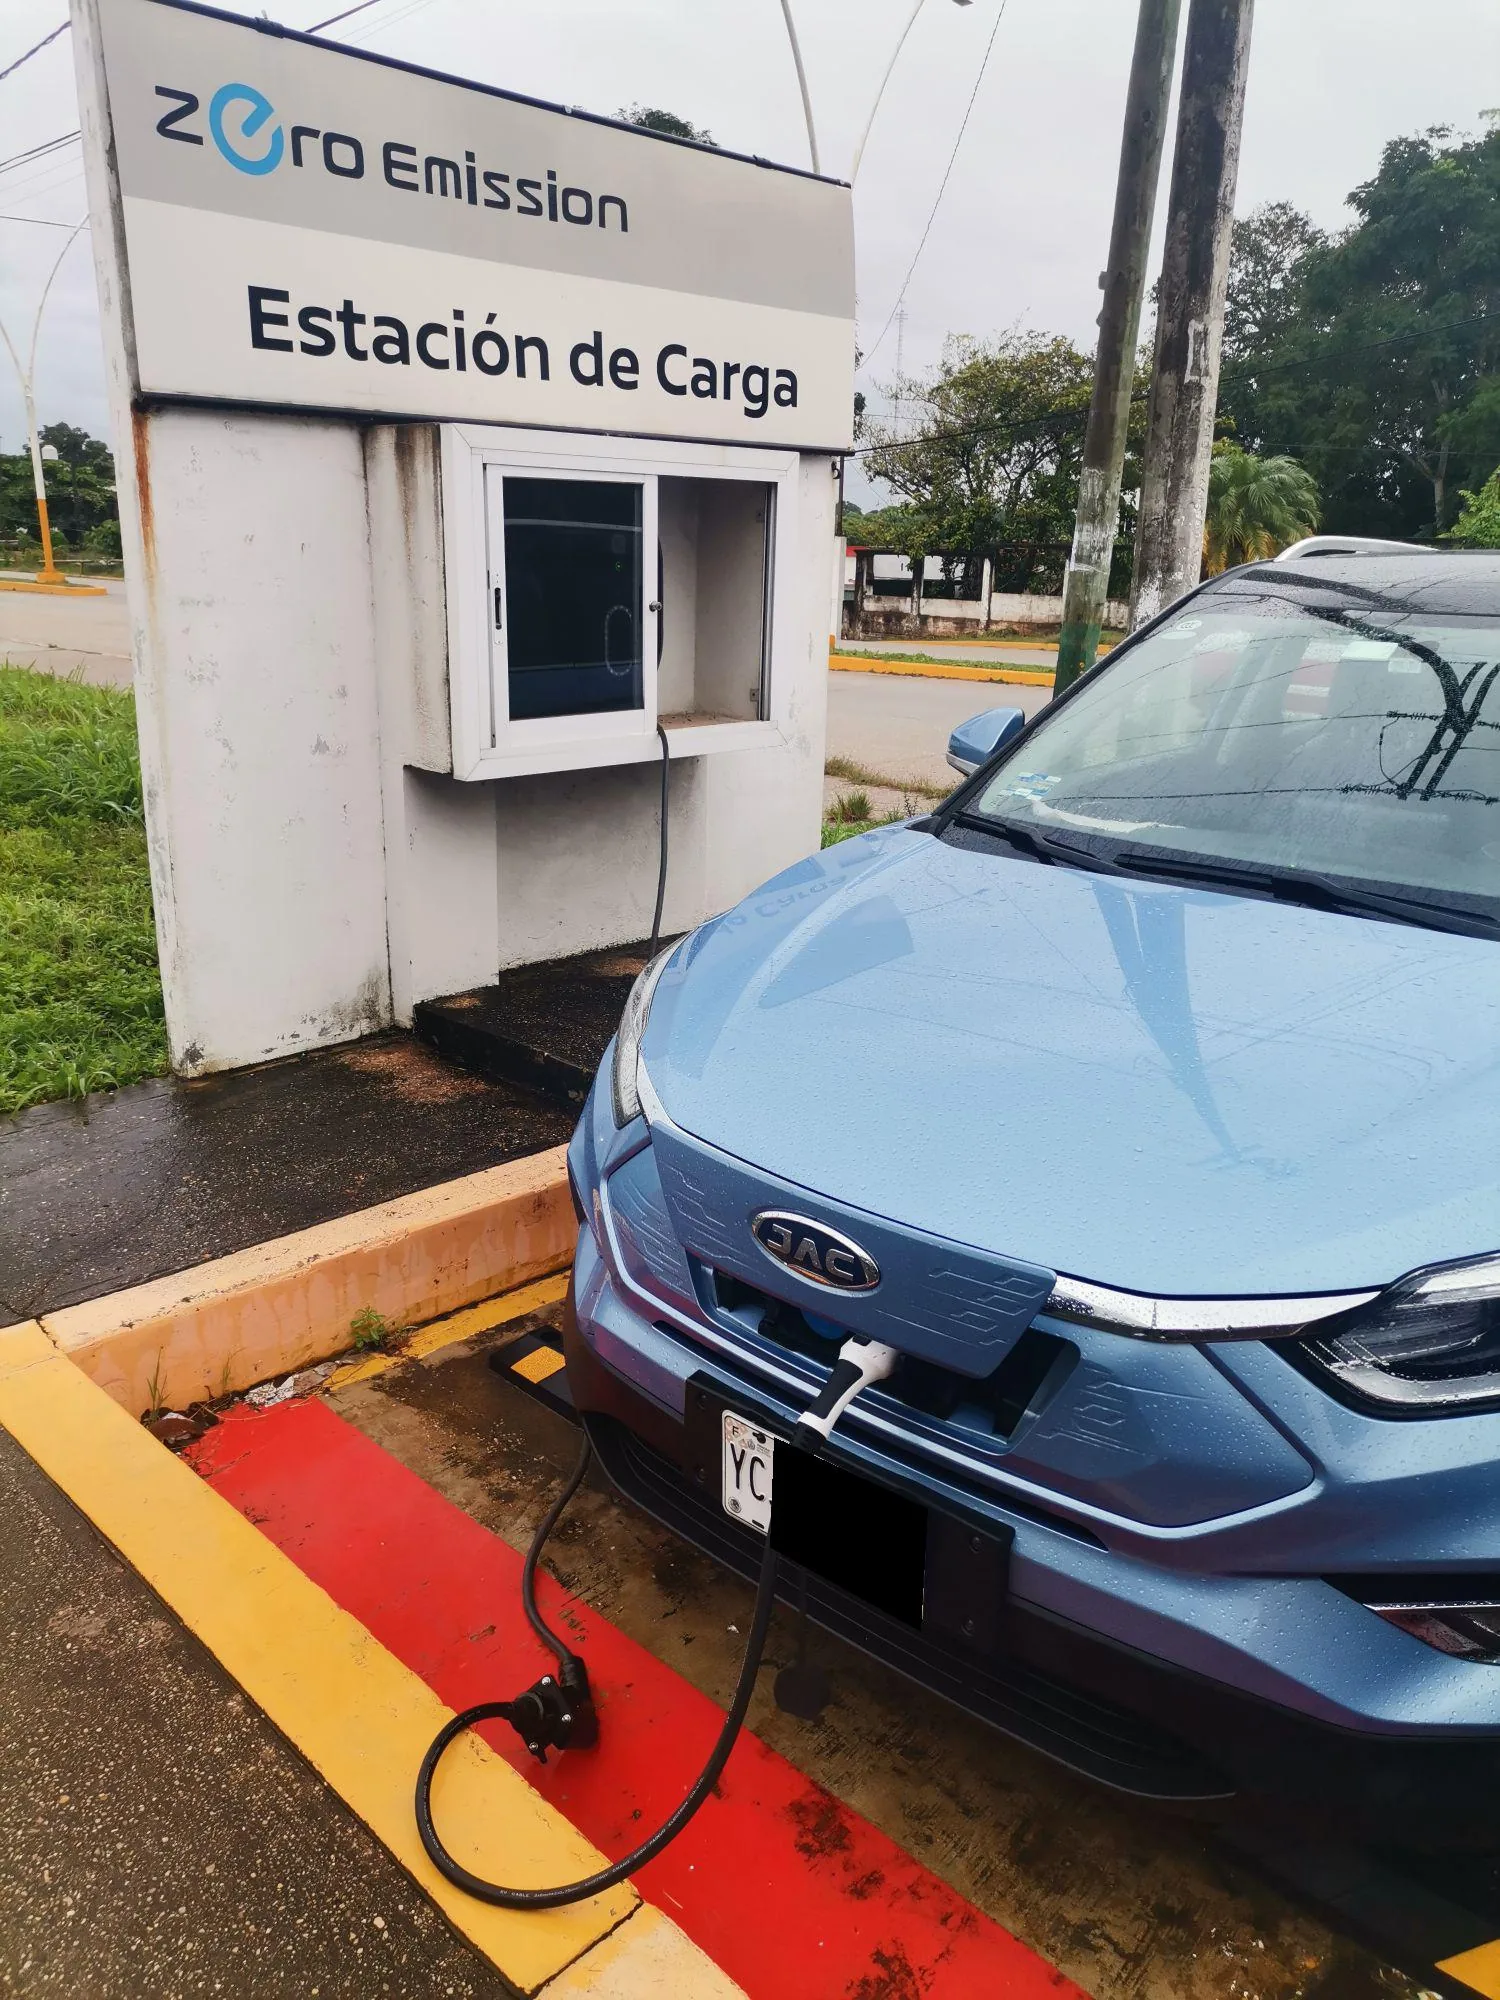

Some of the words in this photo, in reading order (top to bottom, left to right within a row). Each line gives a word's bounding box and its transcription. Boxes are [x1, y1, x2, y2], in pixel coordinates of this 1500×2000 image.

[382, 141, 629, 232] Emission
[247, 285, 550, 381] Estación
[568, 330, 640, 390] de
[655, 343, 798, 419] Carga
[766, 1222, 856, 1282] JAC
[730, 1442, 771, 1504] YC
